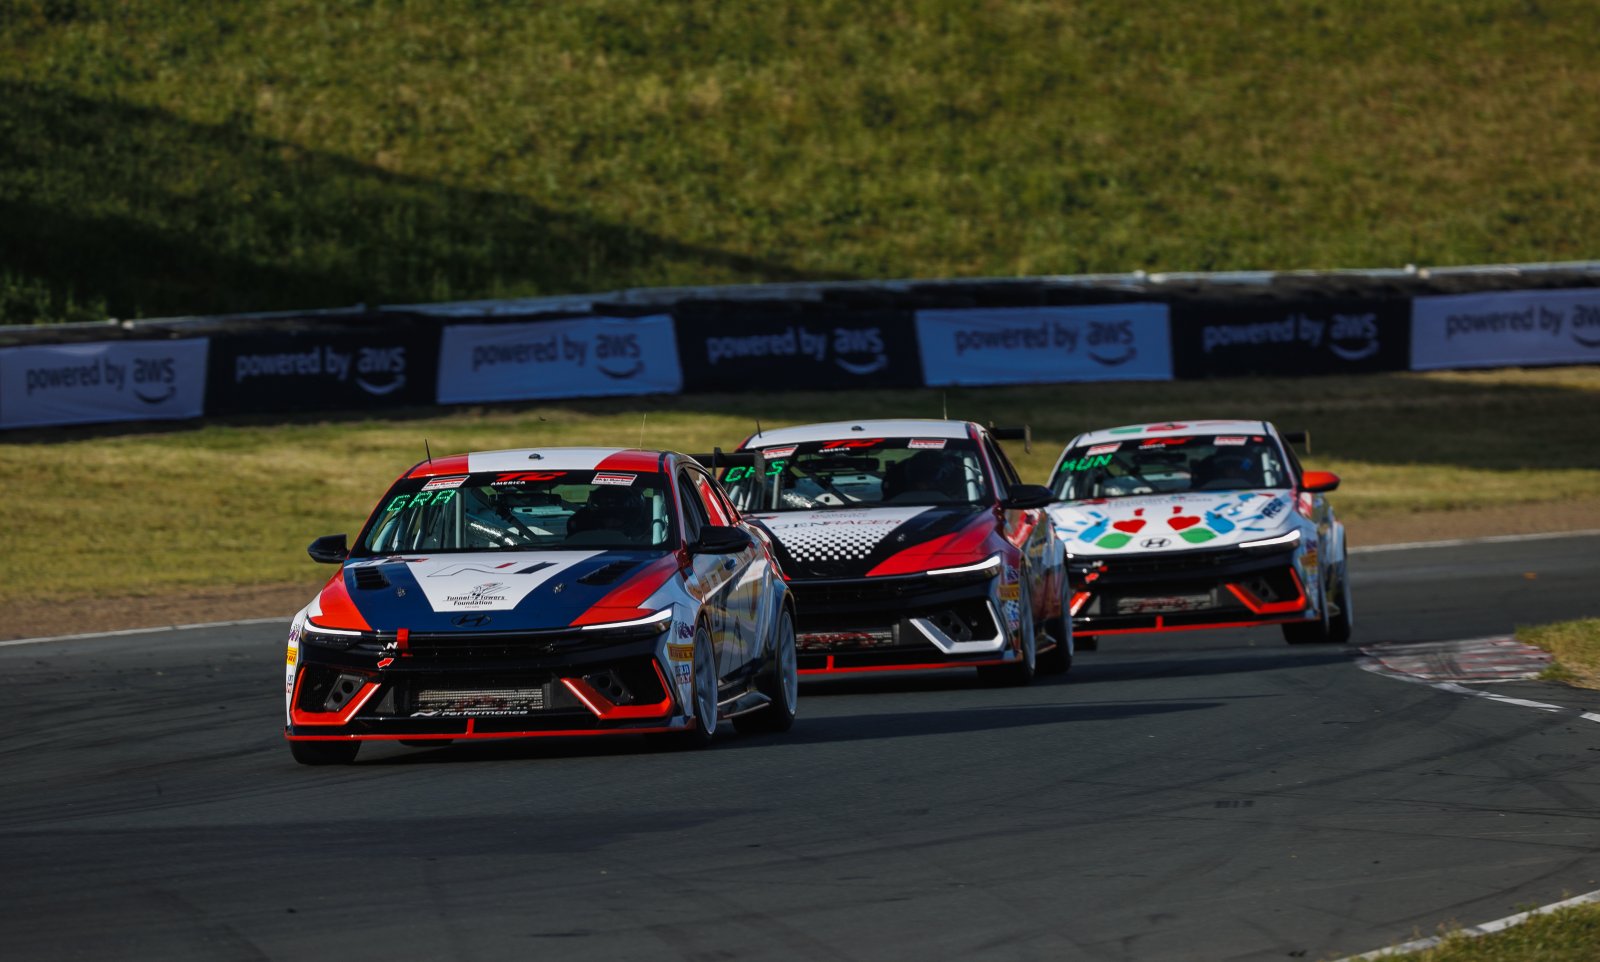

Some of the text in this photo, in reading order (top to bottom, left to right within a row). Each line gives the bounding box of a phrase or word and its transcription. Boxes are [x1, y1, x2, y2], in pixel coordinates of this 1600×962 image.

[954, 319, 1135, 356] powered by aws
[1201, 312, 1379, 353] powered by aws
[1446, 304, 1600, 340] powered by aw
[235, 344, 407, 382] powered by aws
[472, 331, 641, 372] powered by aws
[706, 325, 885, 365] powered by aws
[26, 356, 176, 395] powered by aws
[386, 489, 456, 512] GRA
